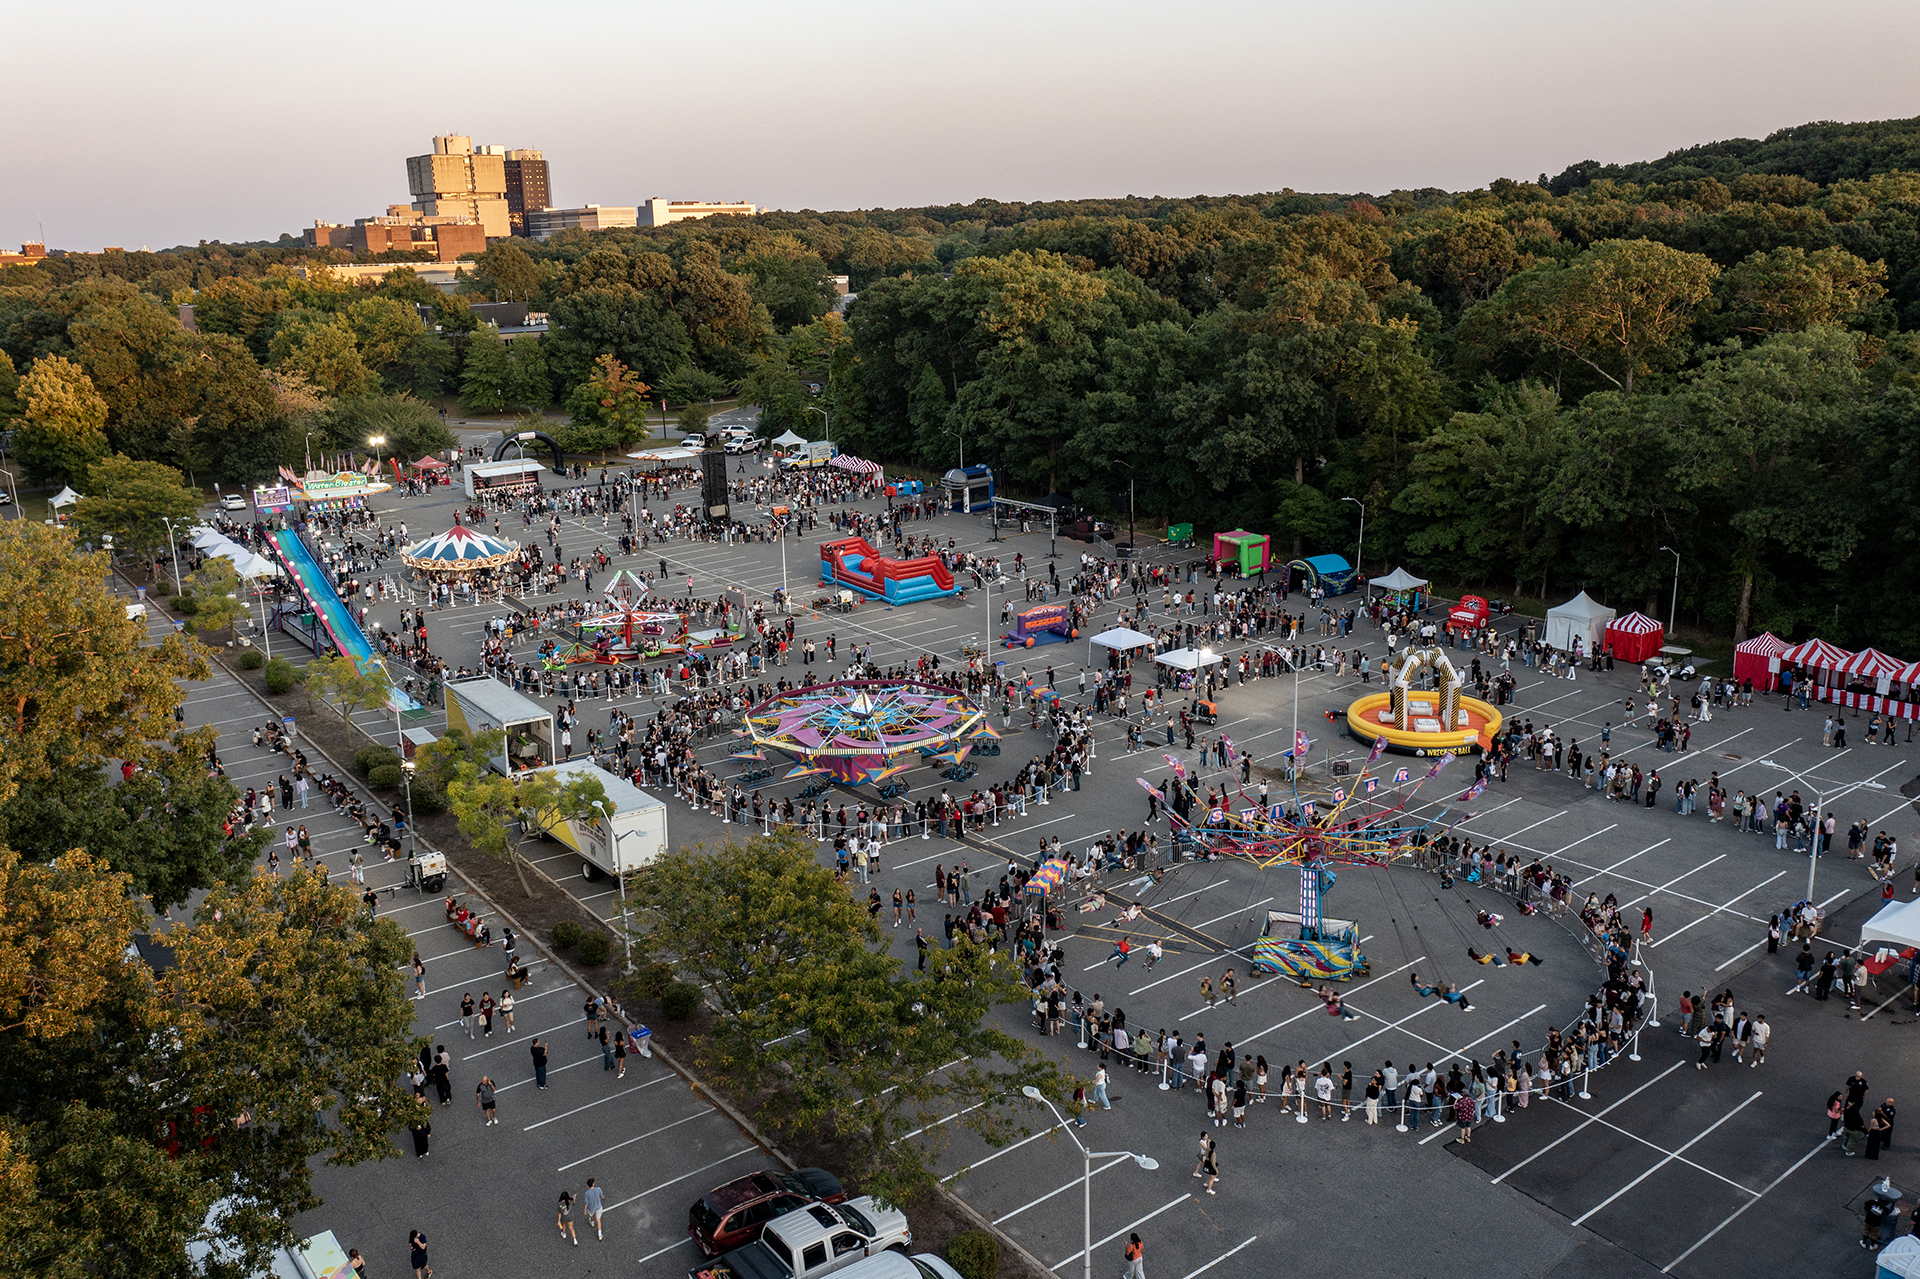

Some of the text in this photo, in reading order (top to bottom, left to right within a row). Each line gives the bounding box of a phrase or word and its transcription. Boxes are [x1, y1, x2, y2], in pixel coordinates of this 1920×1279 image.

[306, 478, 366, 490] Water Blaster
[1426, 745, 1471, 757] WRECKNG BALL
[1026, 886, 1042, 894] ENTER
